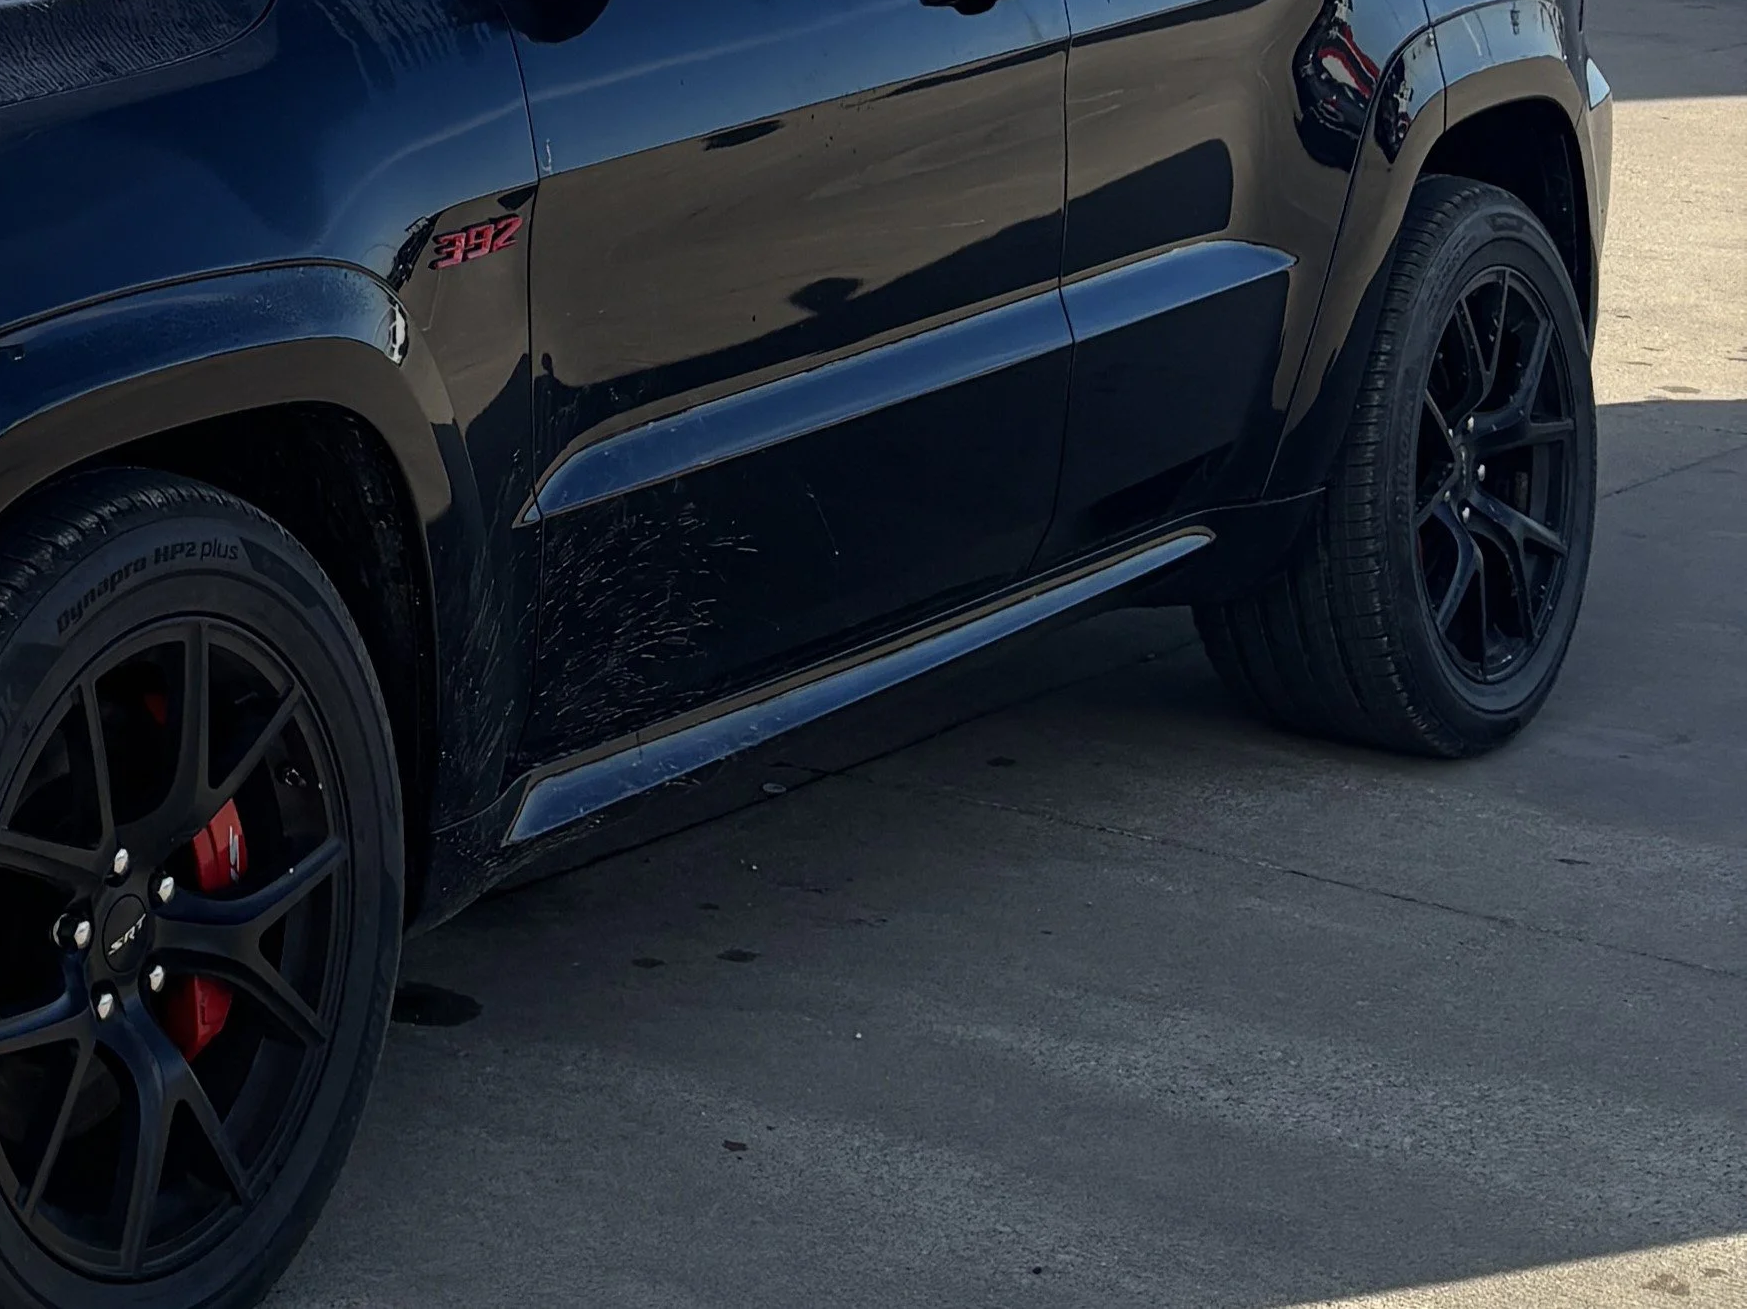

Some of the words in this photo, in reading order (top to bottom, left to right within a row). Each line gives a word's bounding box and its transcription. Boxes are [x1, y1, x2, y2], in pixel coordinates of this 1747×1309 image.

[429, 214, 523, 270] 392
[56, 556, 148, 635] Dynapro
[153, 541, 197, 565] HP2
[199, 538, 240, 562] plus
[108, 913, 146, 956] SRT
